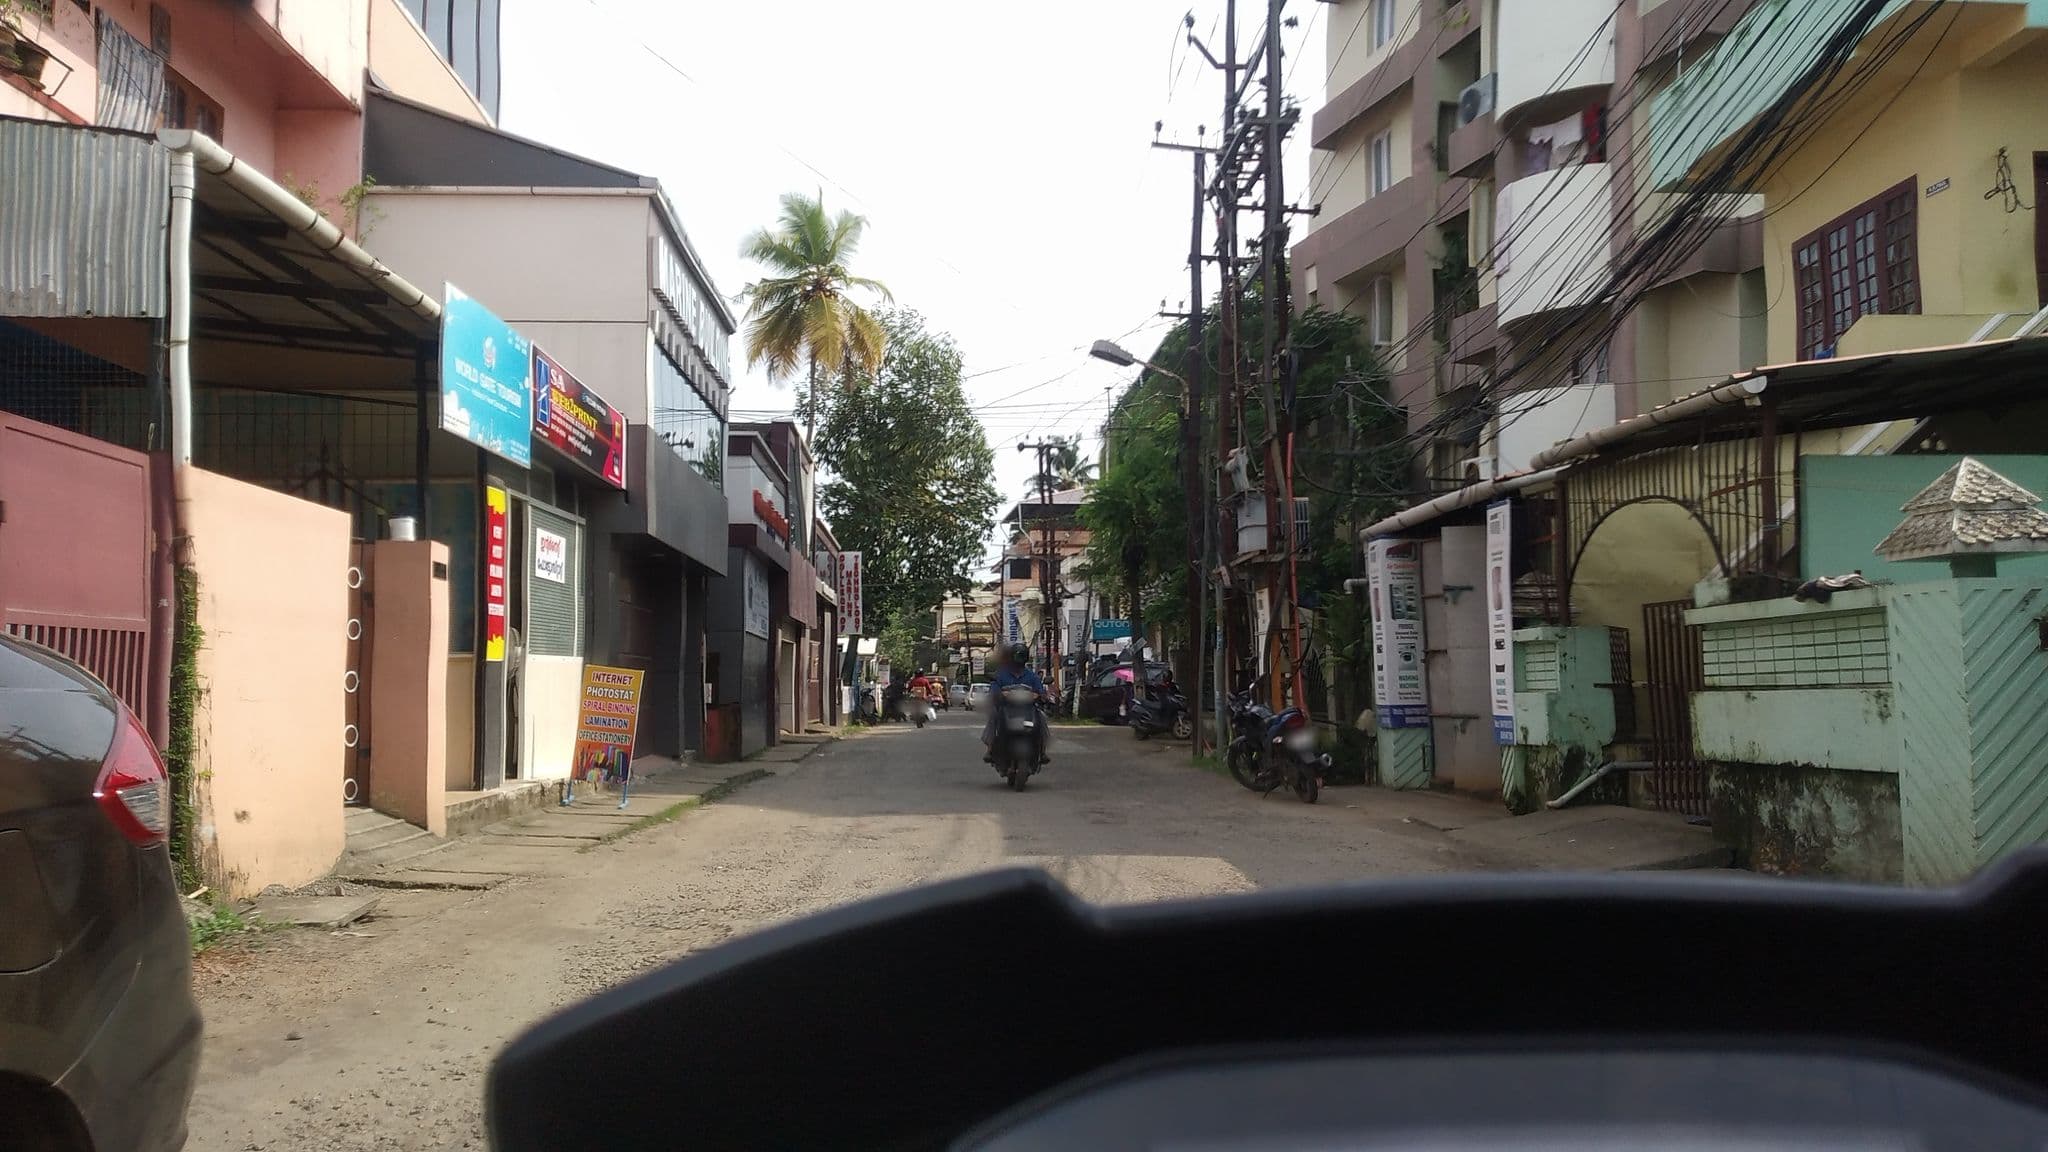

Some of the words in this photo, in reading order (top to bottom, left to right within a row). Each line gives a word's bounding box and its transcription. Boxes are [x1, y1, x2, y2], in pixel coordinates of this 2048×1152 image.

[453, 356, 479, 384] WORLD
[550, 368, 567, 393] SA
[1007, 603, 1018, 642] SAMSUNG
[591, 671, 634, 686] INTERNET
[586, 686, 634, 701] PHOTOSTAT
[583, 700, 606, 712] SPIRAL
[607, 702, 636, 715] BINDING
[585, 715, 629, 729] LAMINATION
[579, 730, 599, 741] OFFICE
[599, 732, 632, 745] STATIONERY
